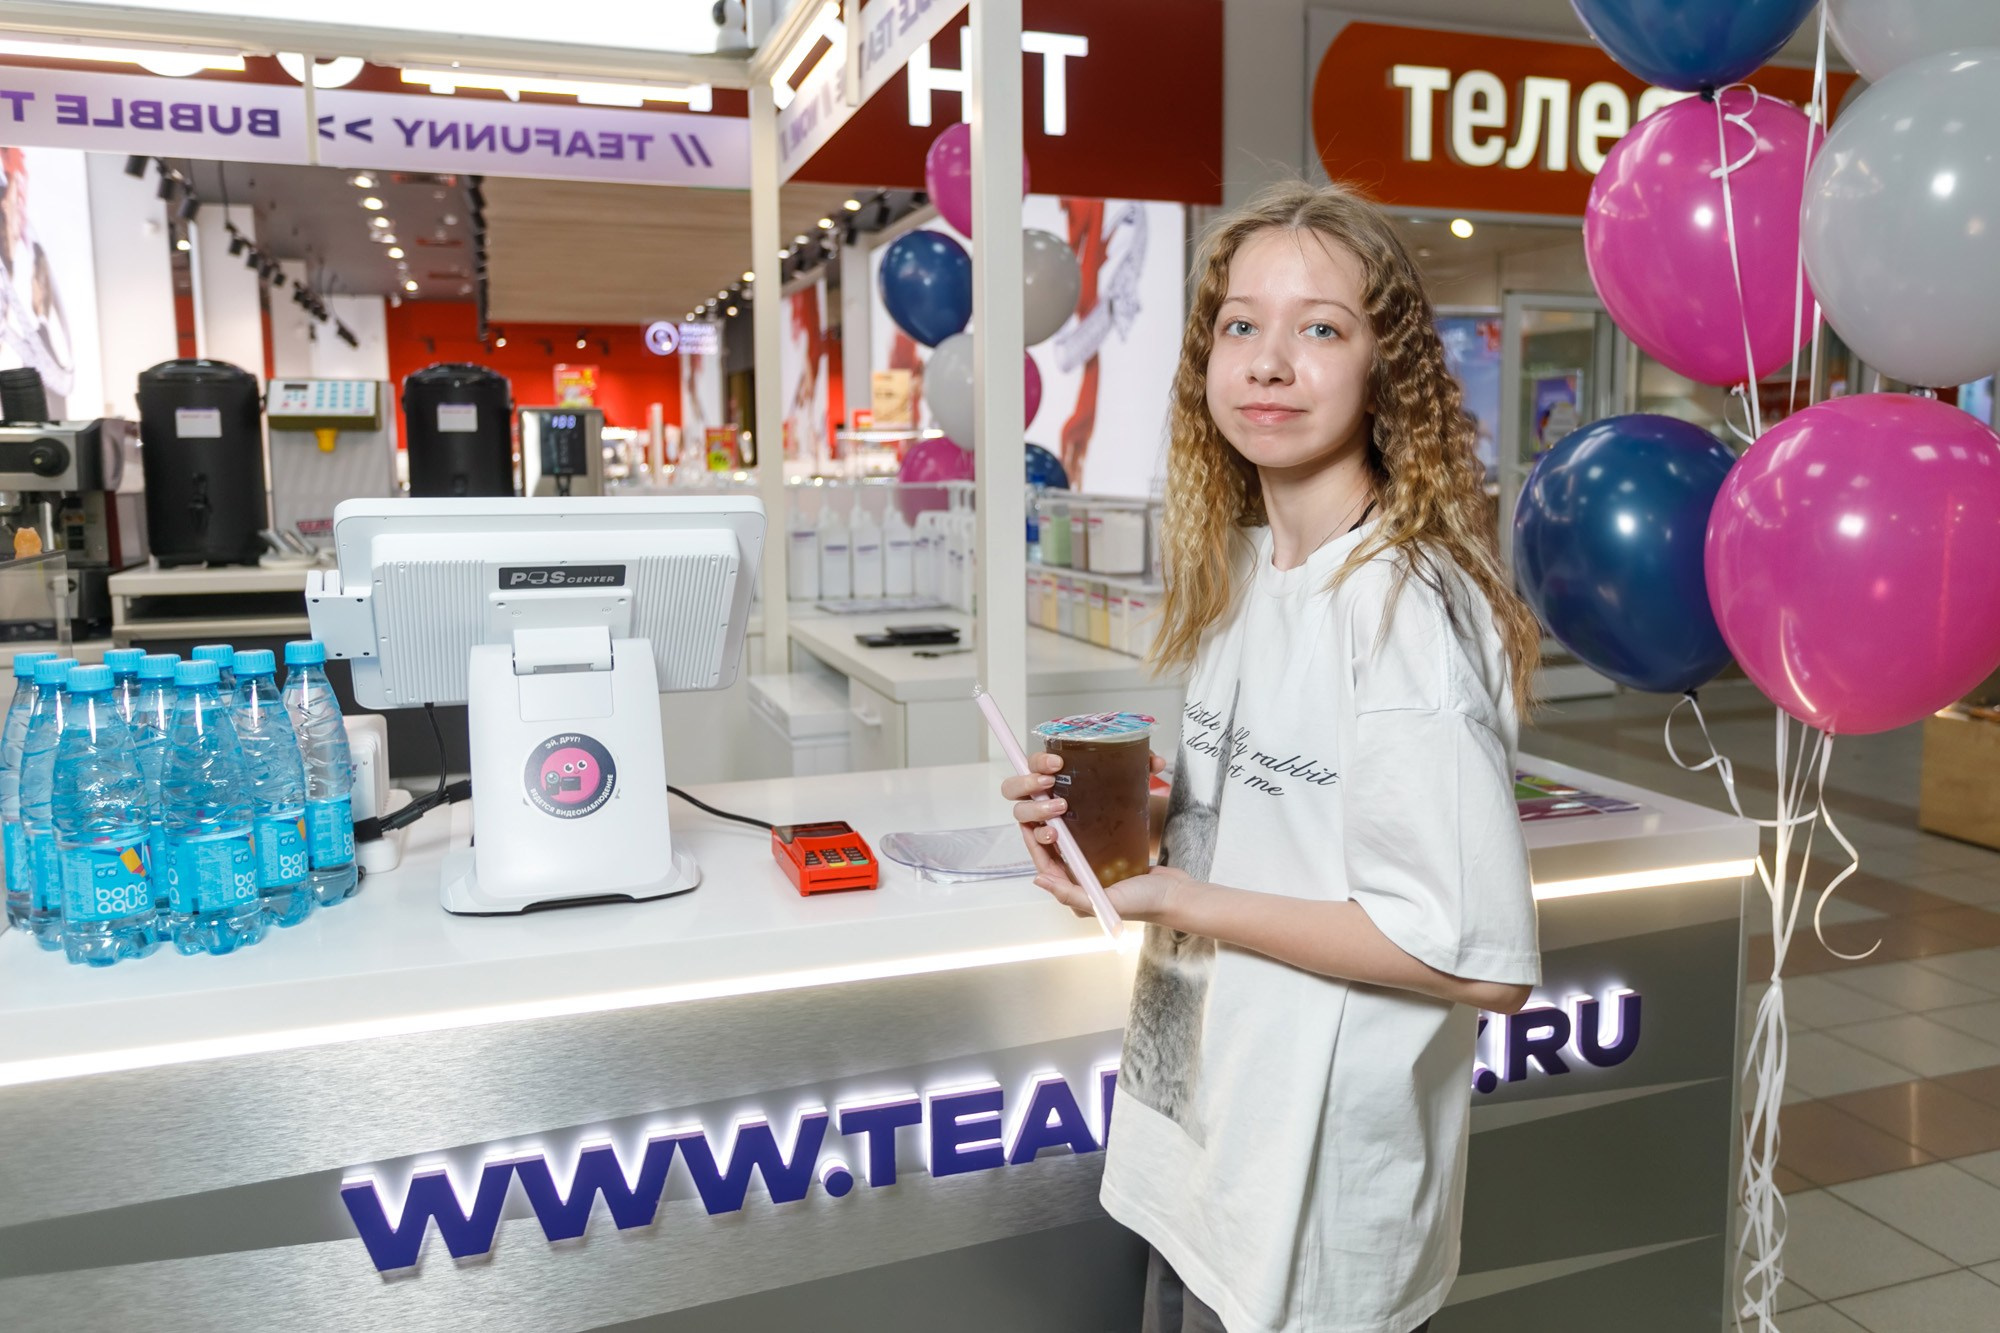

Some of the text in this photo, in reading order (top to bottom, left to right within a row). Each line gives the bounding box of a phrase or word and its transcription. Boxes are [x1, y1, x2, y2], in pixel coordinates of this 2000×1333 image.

[559, 736, 581, 744] ДРУГ!
[1250, 750, 1341, 787] rabbit
[555, 773, 614, 818] ВИДЕОНАБЛЮДЕНИЕ
[1243, 775, 1286, 797] me
[96, 881, 147, 902] bona
[97, 893, 148, 914] aqua
